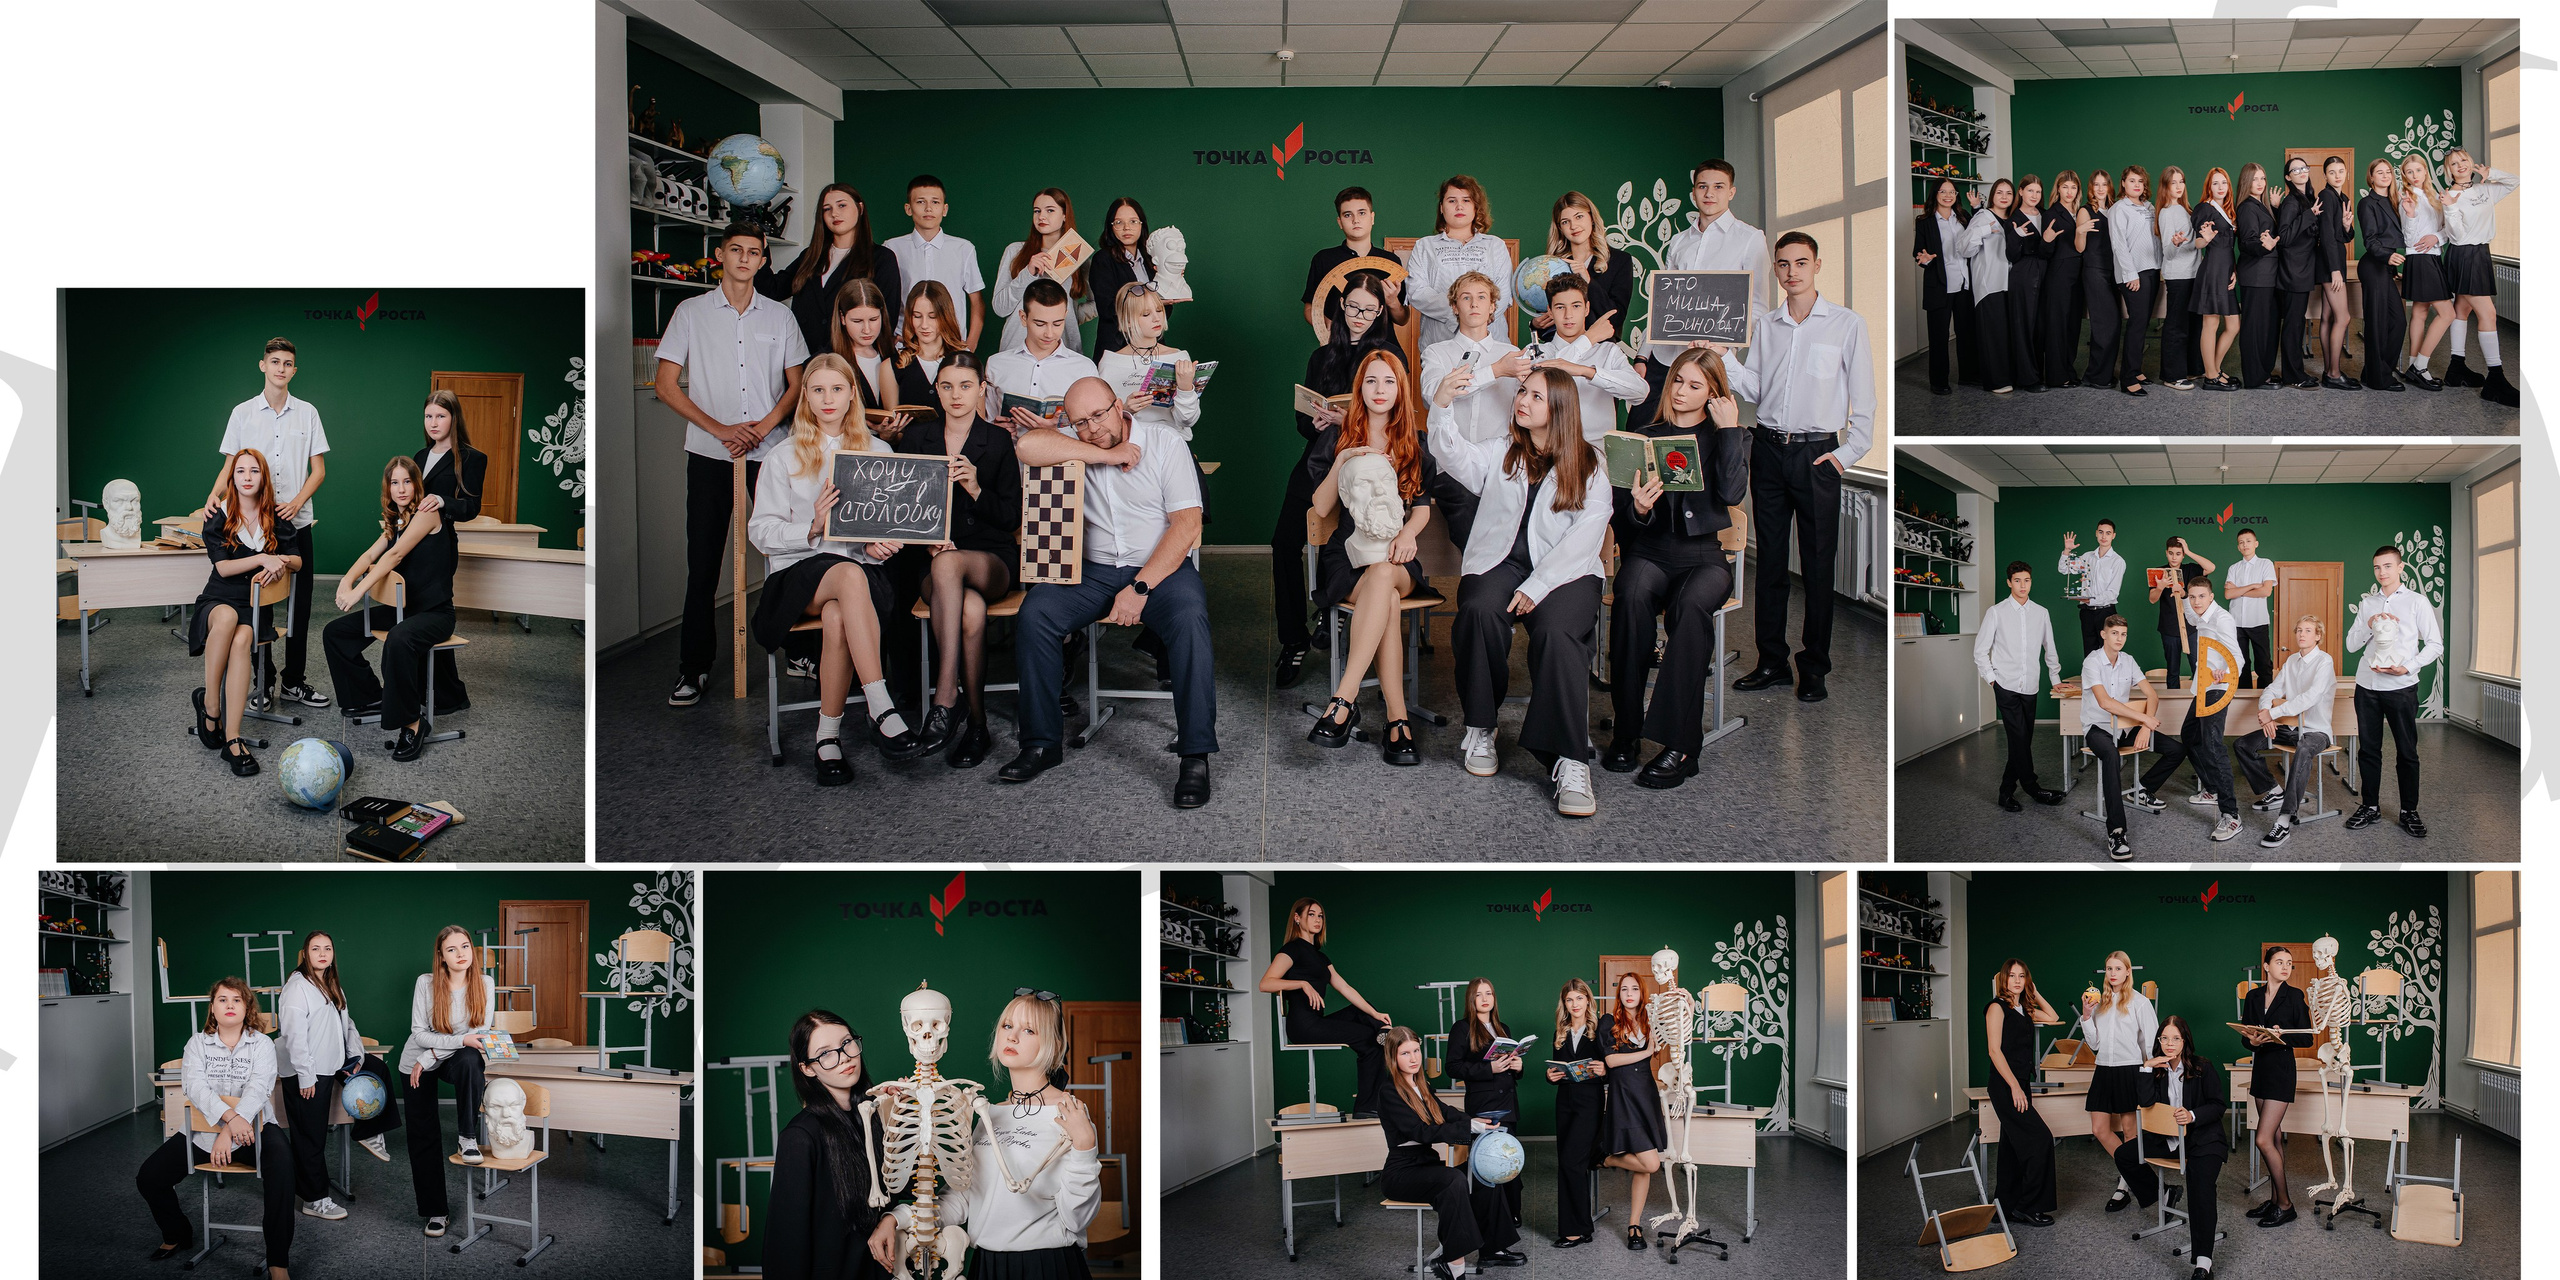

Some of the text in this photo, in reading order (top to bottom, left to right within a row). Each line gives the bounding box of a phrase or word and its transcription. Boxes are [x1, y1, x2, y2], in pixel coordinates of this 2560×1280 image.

[2188, 103, 2279, 114] ТОЧКА РОСТА
[1192, 149, 1374, 165] ТОЧКА РОСТА
[1661, 276, 1698, 291] ЭТО
[303, 309, 426, 321] ТОЧКА РОСТА
[853, 459, 918, 491] ХОЧУ
[2176, 516, 2269, 525] ТОЧКА РОСТА
[2158, 895, 2256, 904] ТОЧКА РОСТА
[838, 899, 1049, 920] ТОЧКА РОСТА
[1486, 903, 1593, 913] ТОЧКА РОСТА
